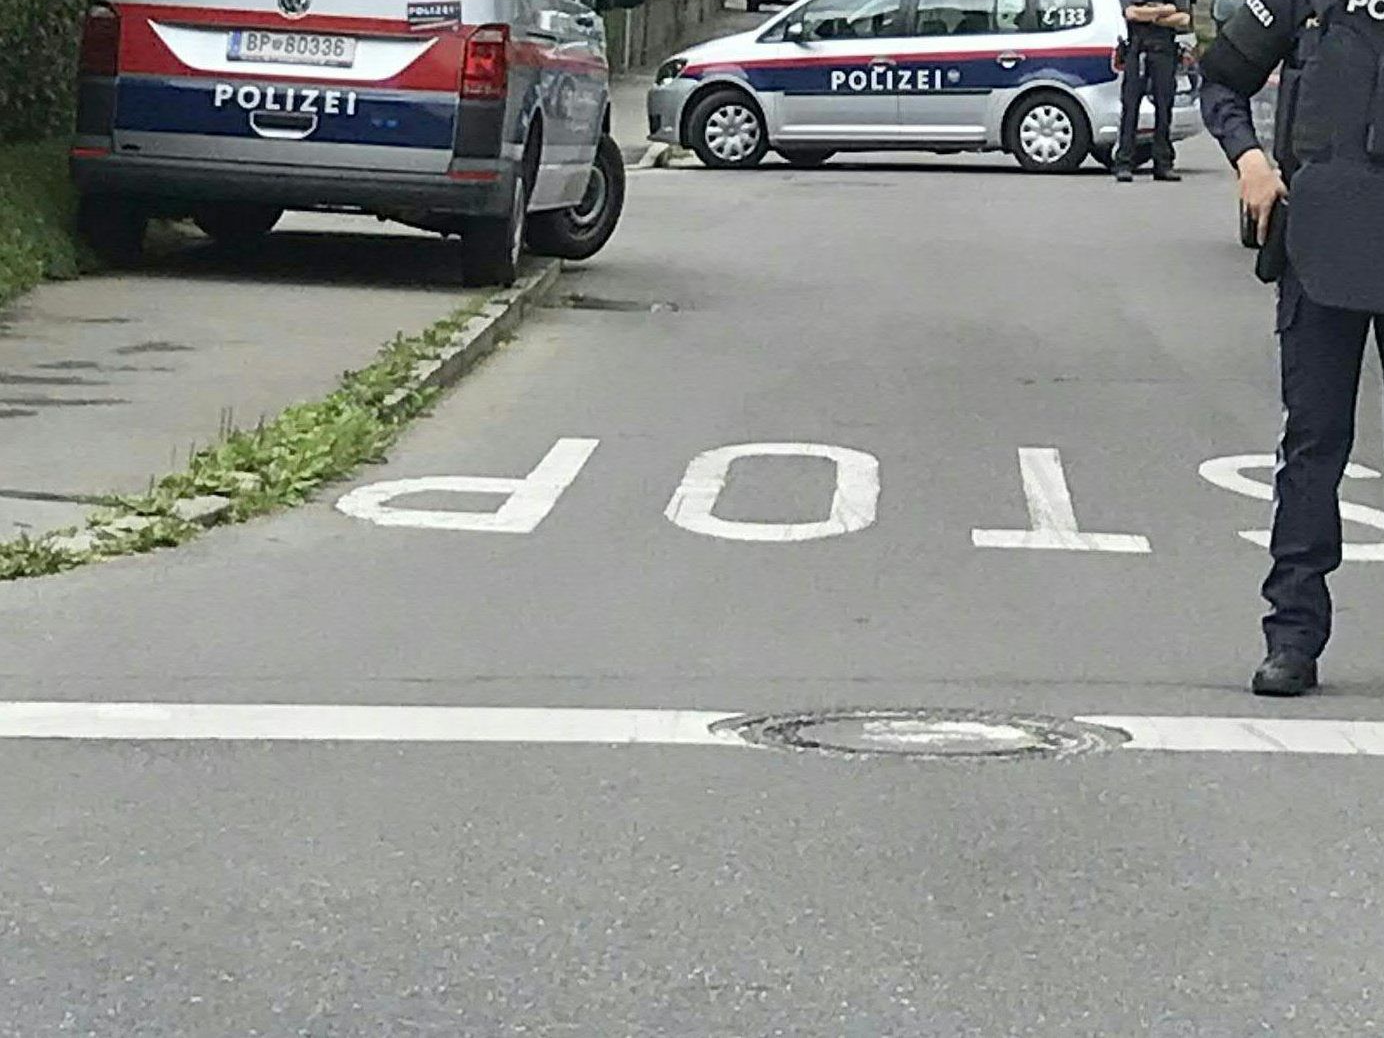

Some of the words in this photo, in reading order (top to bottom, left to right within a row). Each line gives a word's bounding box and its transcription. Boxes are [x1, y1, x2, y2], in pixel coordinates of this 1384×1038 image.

[1059, 8, 1086, 26] 133
[246, 33, 270, 51] BP
[831, 69, 942, 91] POLIZEI
[215, 84, 357, 115] POLIZEI
